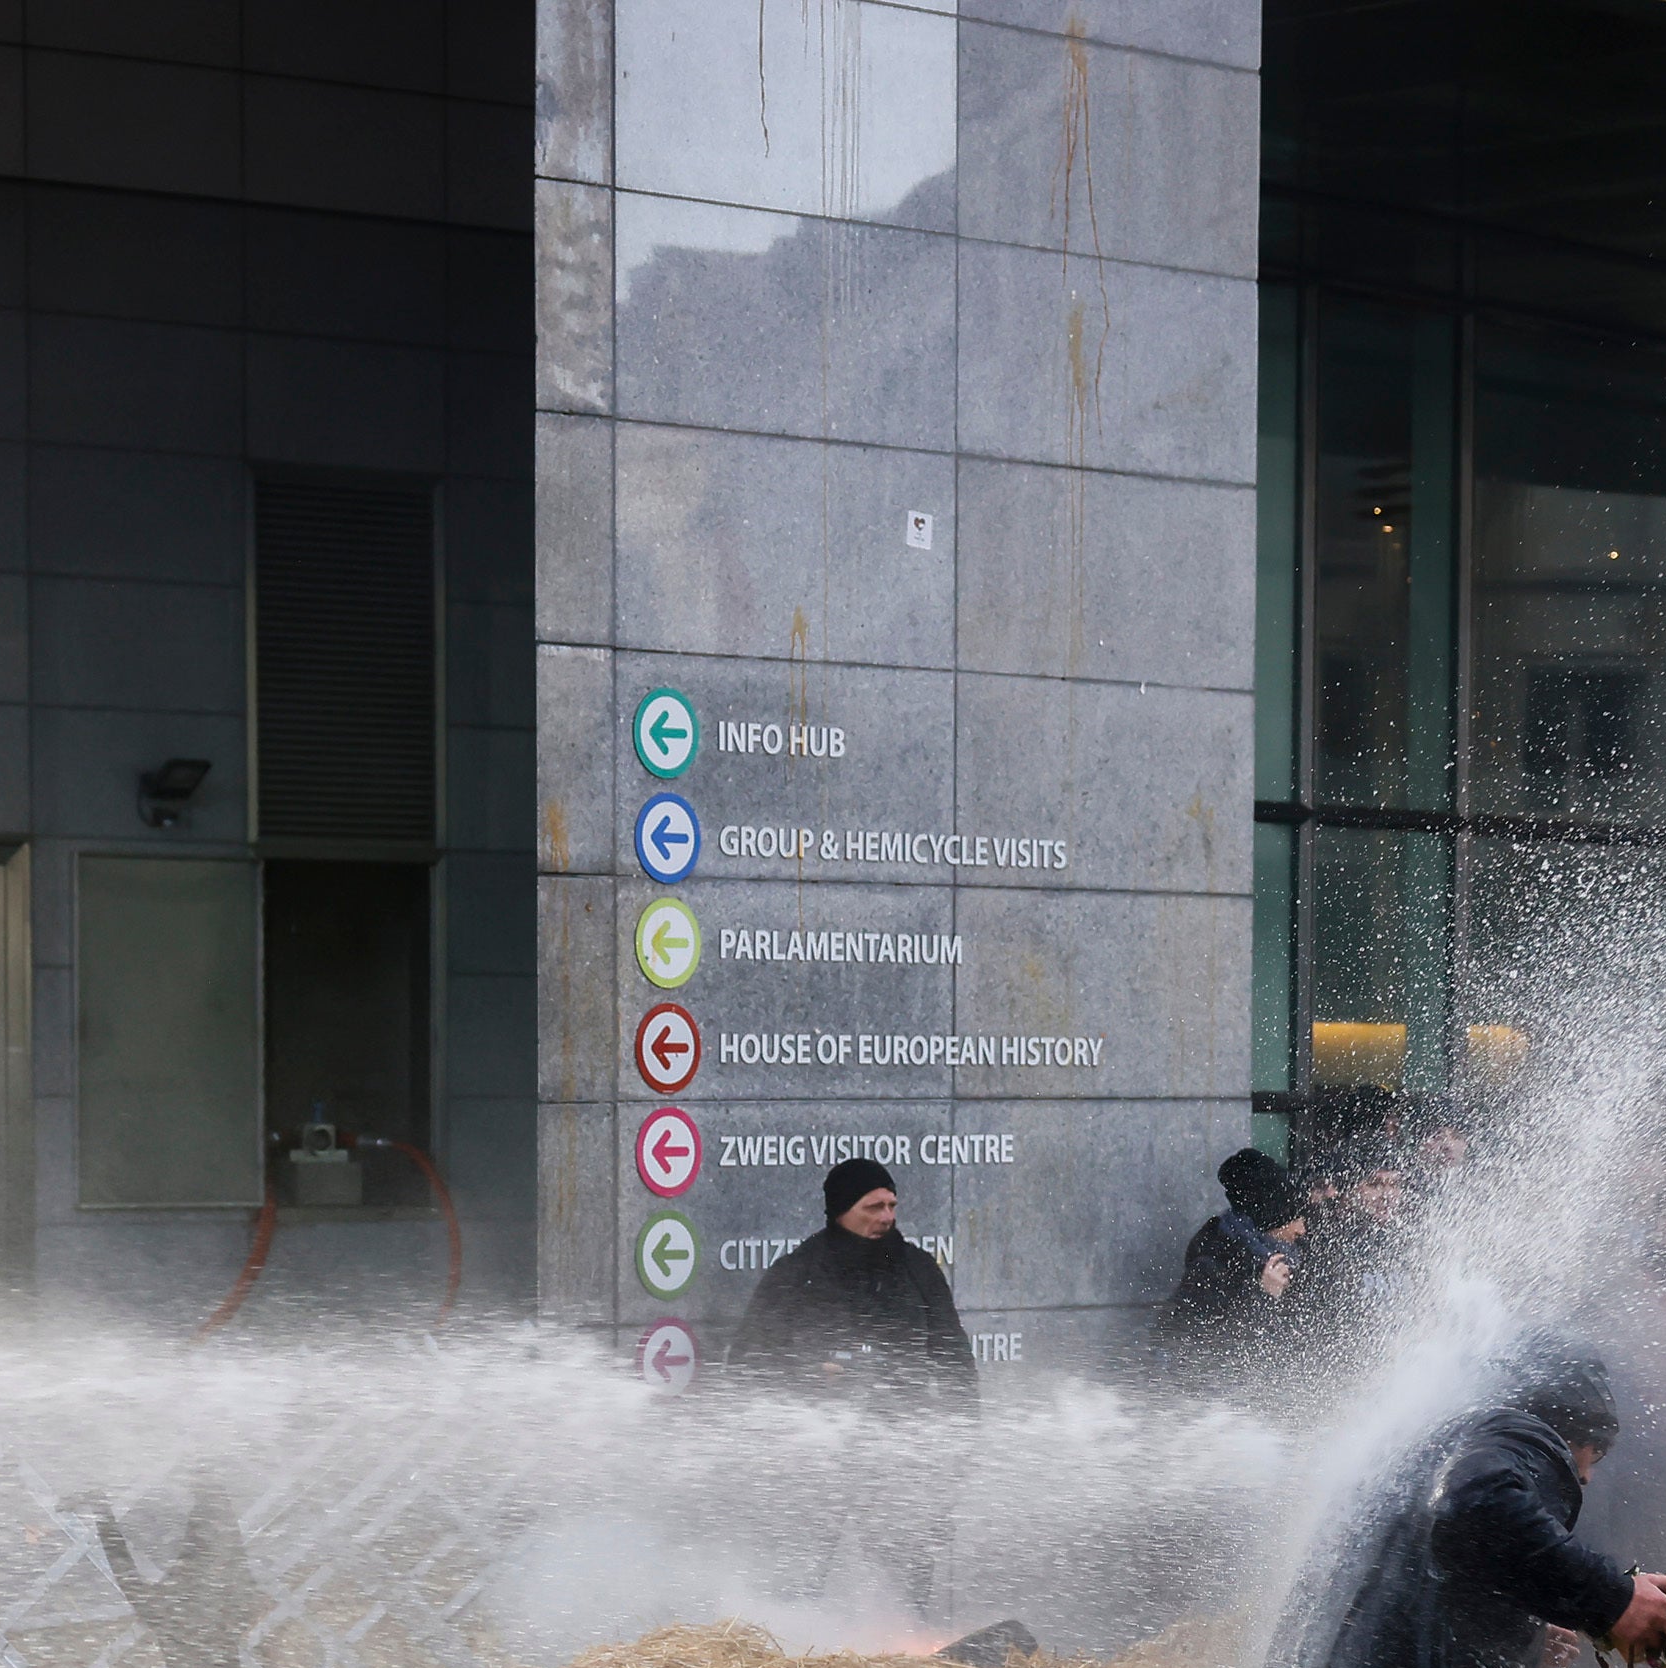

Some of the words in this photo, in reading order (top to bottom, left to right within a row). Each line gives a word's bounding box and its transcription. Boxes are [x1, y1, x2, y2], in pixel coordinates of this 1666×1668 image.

[717, 721, 783, 755] INFO
[789, 725, 846, 757] HUB
[719, 825, 814, 859] GROUP
[819, 829, 840, 860] &
[845, 830, 989, 867] HEMICYCLE
[993, 837, 1067, 870] VISITS
[719, 929, 963, 965] PARLAMENTARIUM
[719, 1033, 811, 1065] HOUSE
[816, 1034, 852, 1065] OF
[858, 1035, 996, 1066] EUROPEAN
[1001, 1037, 1104, 1067] HISTORY
[719, 1135, 805, 1167] ZWEIG
[809, 1134, 911, 1165] VISITOR
[920, 1134, 1014, 1165] CENTRE
